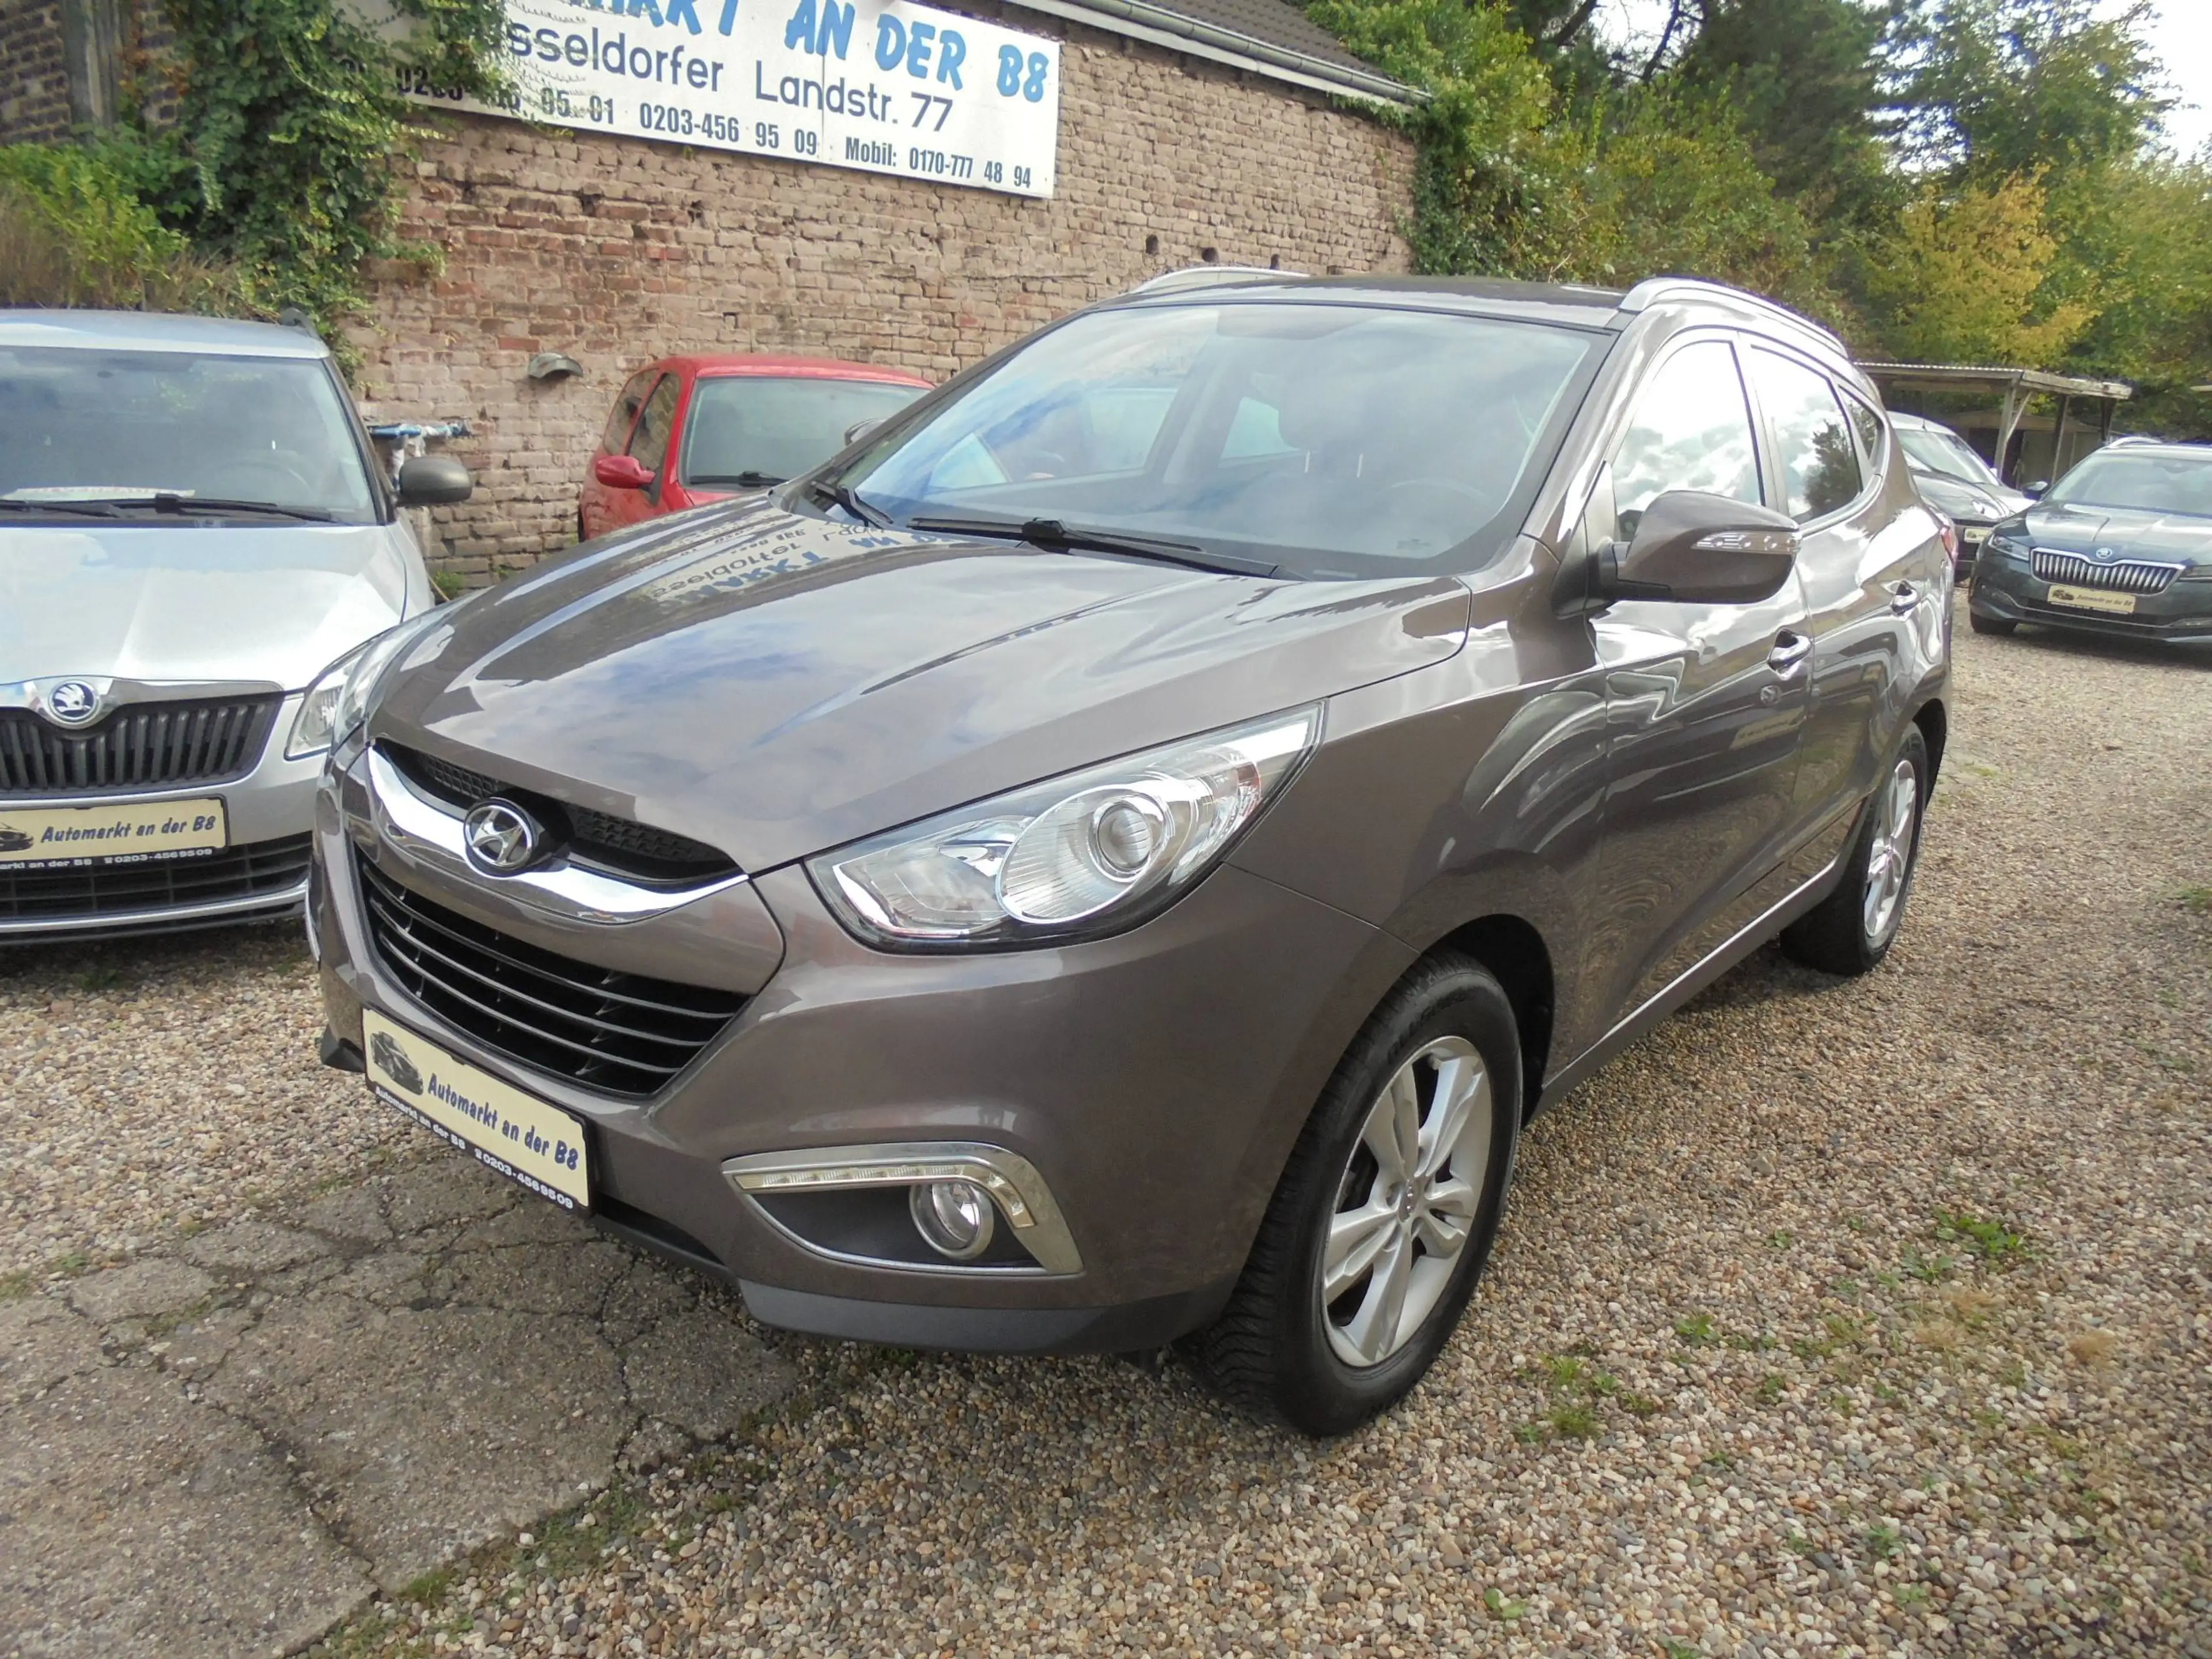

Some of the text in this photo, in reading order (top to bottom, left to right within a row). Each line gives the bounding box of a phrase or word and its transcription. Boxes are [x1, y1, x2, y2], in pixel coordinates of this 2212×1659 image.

[507, 22, 724, 92] sseldorfer
[755, 60, 898, 123] Landstr.
[911, 92, 953, 132] 77
[784, 0, 855, 60] AN
[874, 13, 967, 91] DER
[997, 44, 1050, 103] B8
[639, 103, 739, 142] 0203-456
[755, 122, 779, 149] 95
[794, 128, 817, 156] 09
[845, 136, 897, 167] Mobil:
[909, 147, 974, 179] 0170-777
[984, 160, 1003, 184] 48
[1013, 165, 1031, 189] 94
[40, 816, 217, 843] Automarkt an der B8
[427, 1072, 579, 1171] Automarkt an der B8
